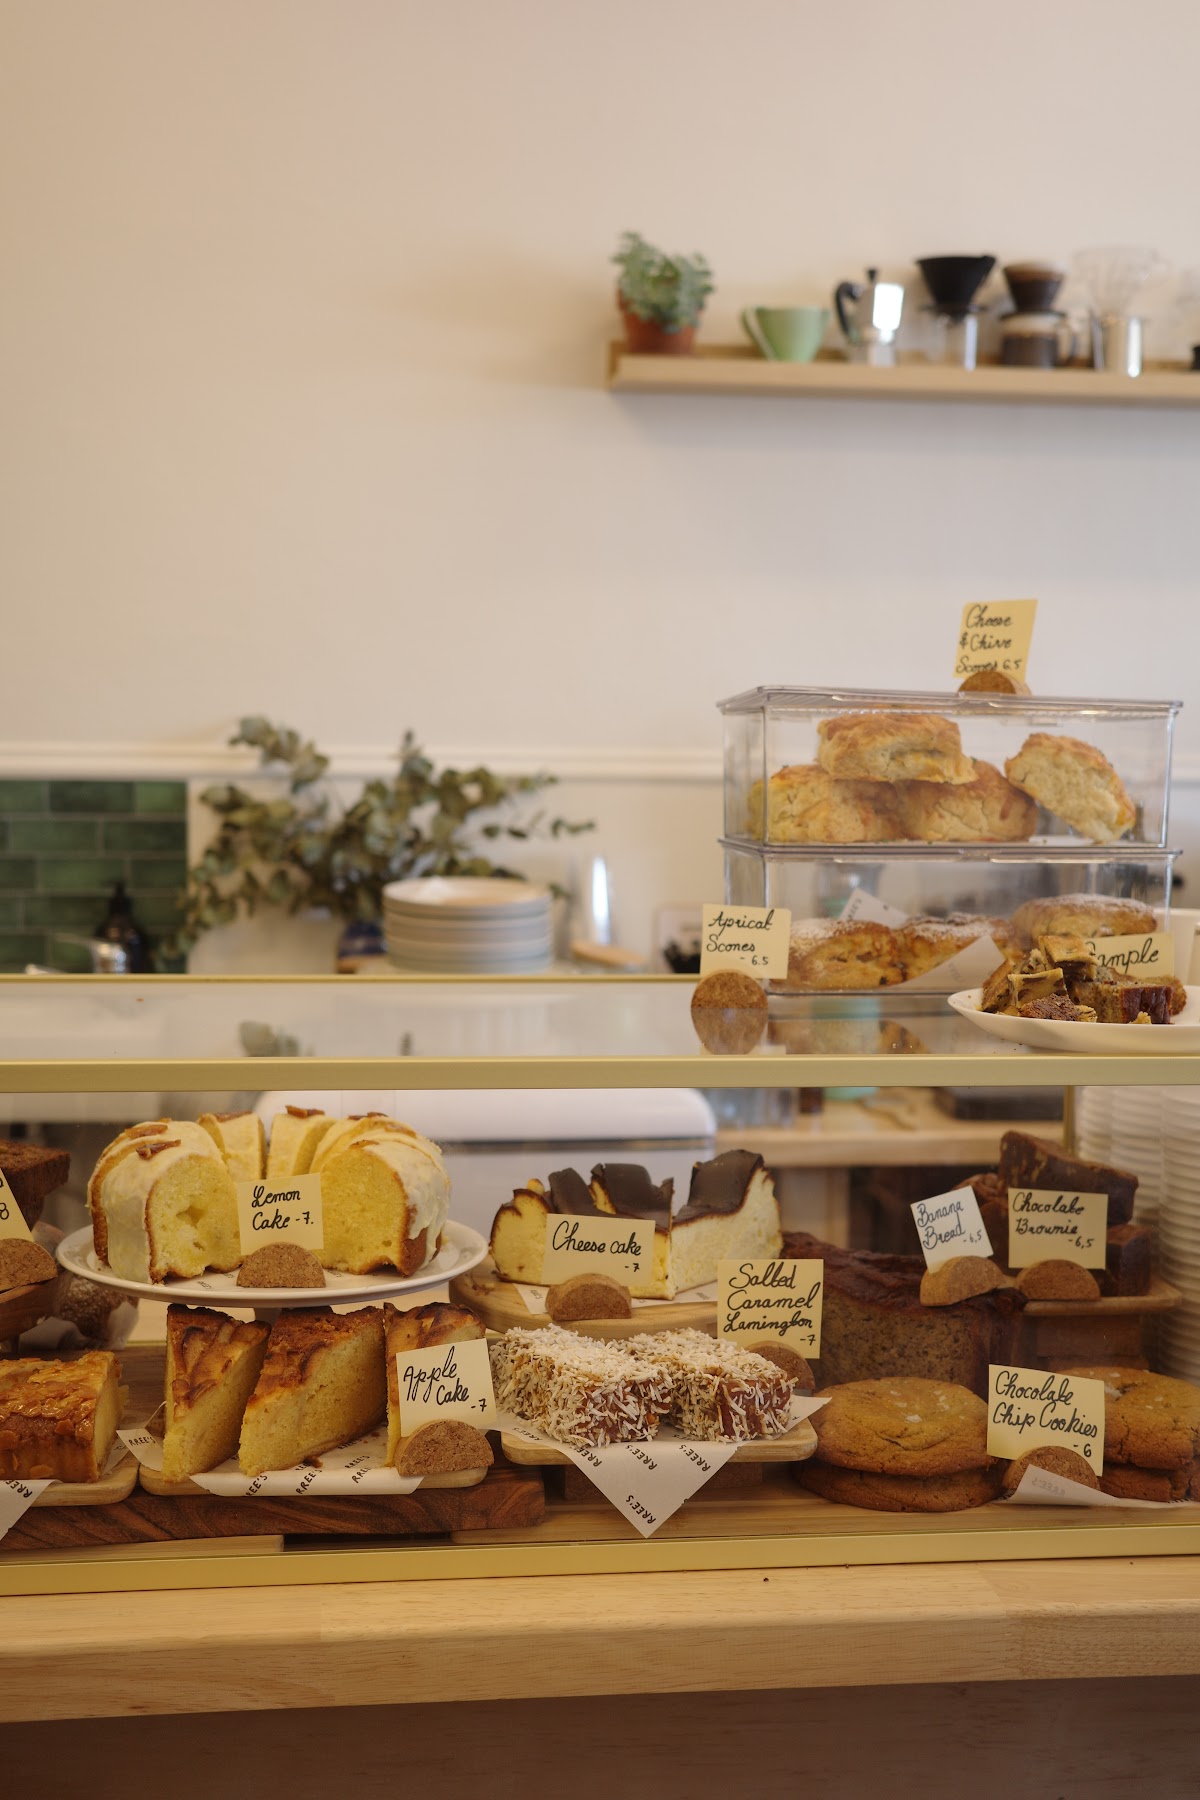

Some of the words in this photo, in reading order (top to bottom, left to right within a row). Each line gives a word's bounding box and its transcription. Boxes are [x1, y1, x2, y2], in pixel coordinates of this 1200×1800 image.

[966, 604, 1013, 629] Cheese
[970, 633, 1012, 652] Chive
[708, 909, 775, 937] Apricot
[706, 933, 756, 952] Scones
[251, 1185, 301, 1208] Lemon
[1012, 1191, 1084, 1215] Chocolate
[252, 1208, 291, 1231] Cake
[916, 1201, 964, 1228] Banana
[1015, 1218, 1079, 1235] Brownie
[922, 1211, 966, 1250] Bread
[728, 1261, 797, 1289] Salted
[727, 1281, 821, 1311] Caramel
[723, 1310, 813, 1337] Lamington
[403, 1345, 457, 1404] Apple
[995, 1370, 1074, 1406] Chocolate
[436, 1377, 470, 1406] Cake
[992, 1401, 1036, 1435] Chip
[1039, 1401, 1098, 1438] Cookies
[625, 1444, 658, 1471] RREE'S
[678, 1444, 712, 1472] RREE'S
[625, 1494, 657, 1525] RREE'S
